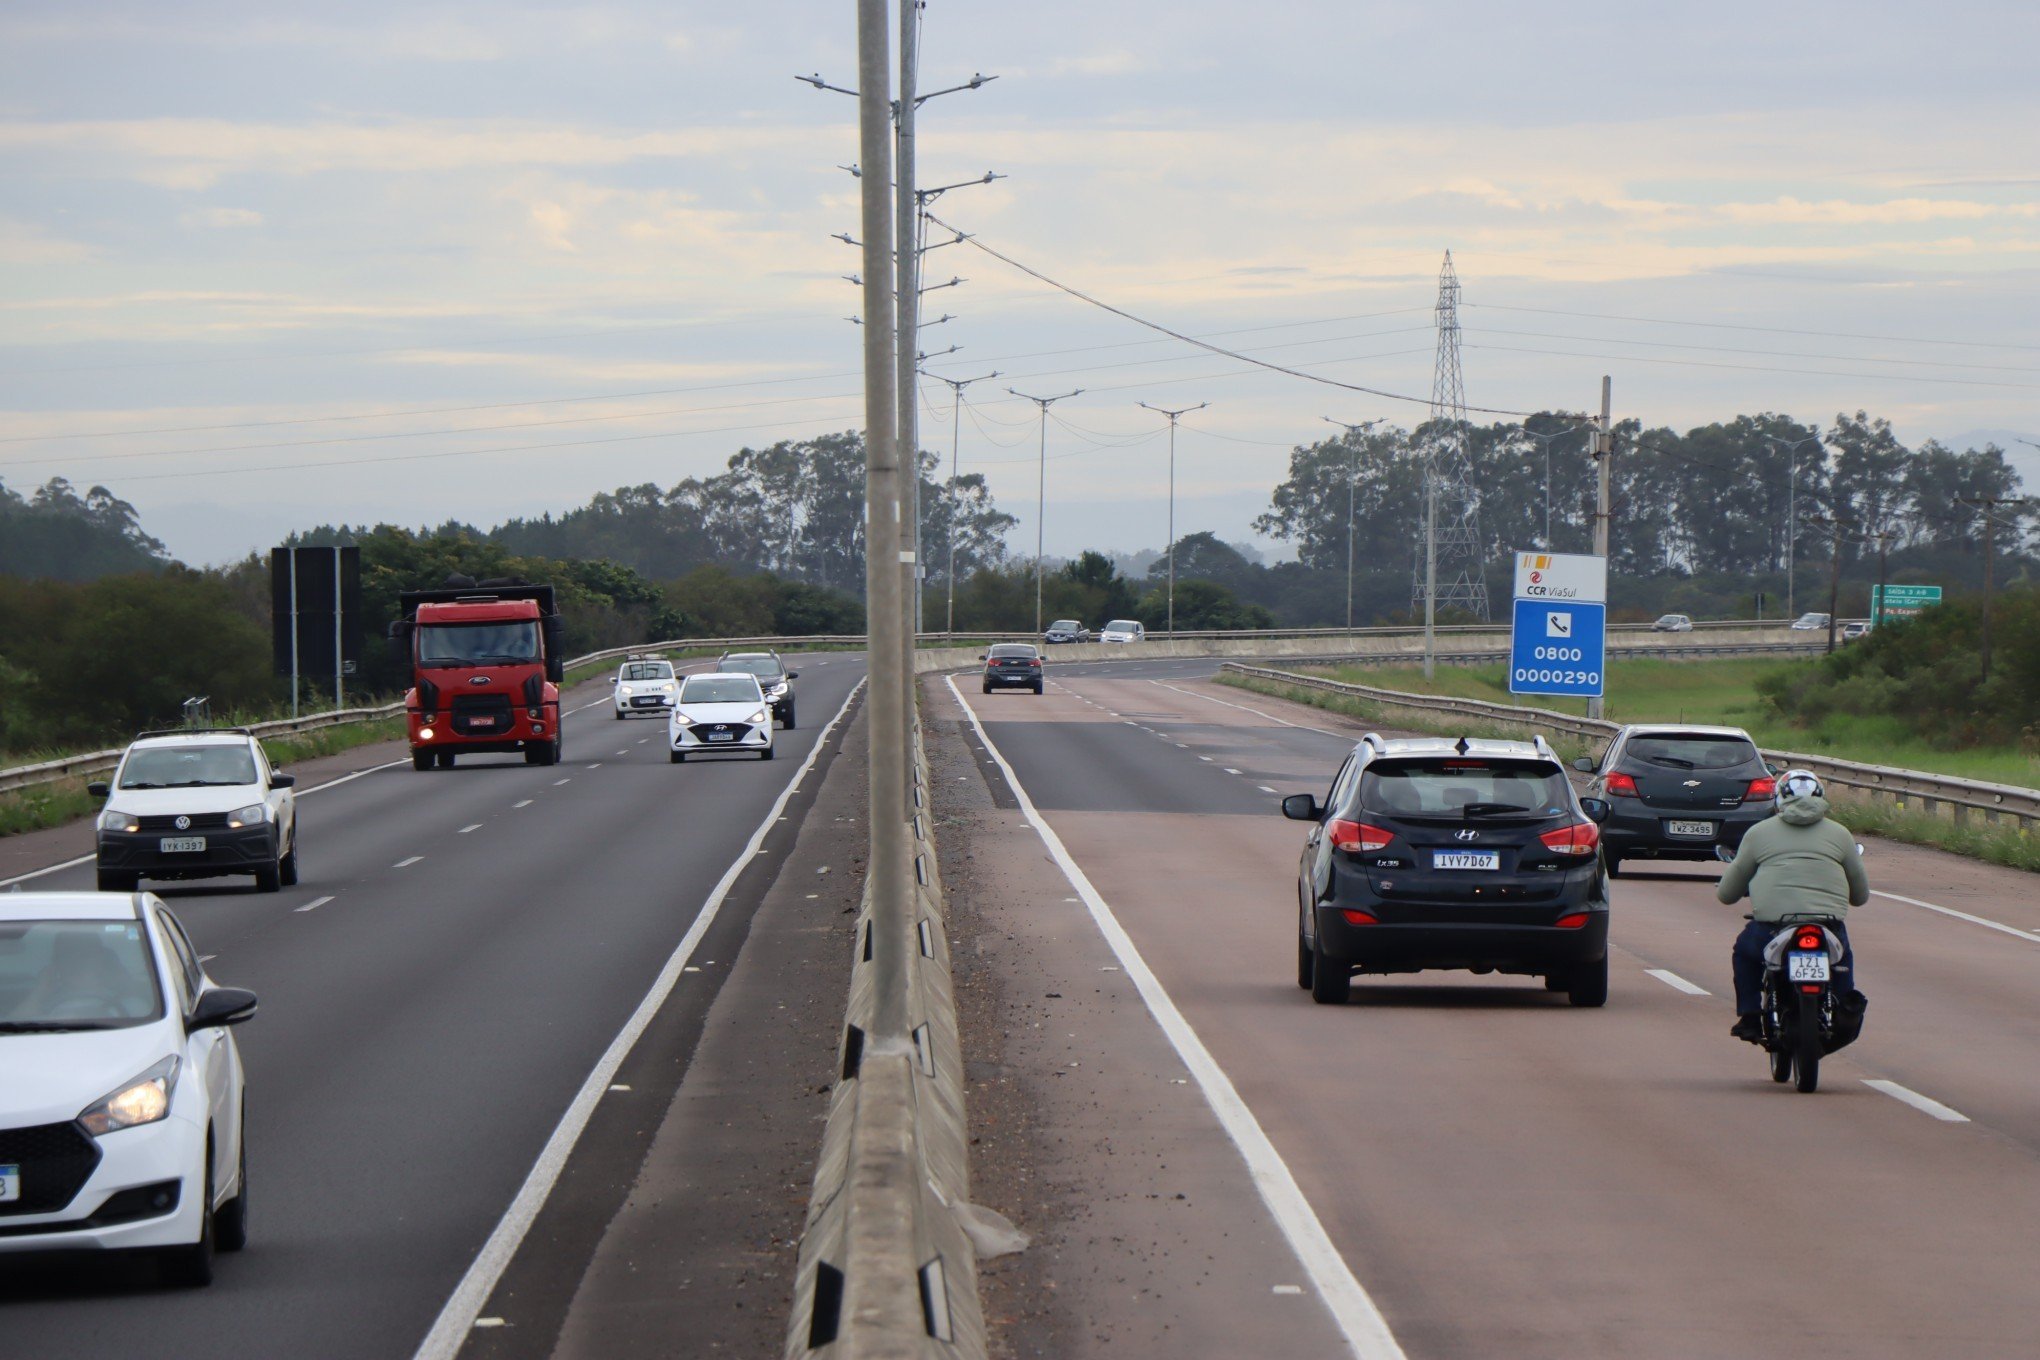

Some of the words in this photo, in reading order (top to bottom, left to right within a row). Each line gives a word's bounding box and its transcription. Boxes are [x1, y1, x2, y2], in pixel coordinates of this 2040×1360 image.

[1527, 586, 1546, 595] CCR
[1549, 587, 1576, 597] ViaSul
[1534, 646, 1582, 662] 0800
[1515, 668, 1599, 685] 0000290
[1441, 855, 1492, 867] IYY7D67
[1795, 967, 1825, 979] 6F25
